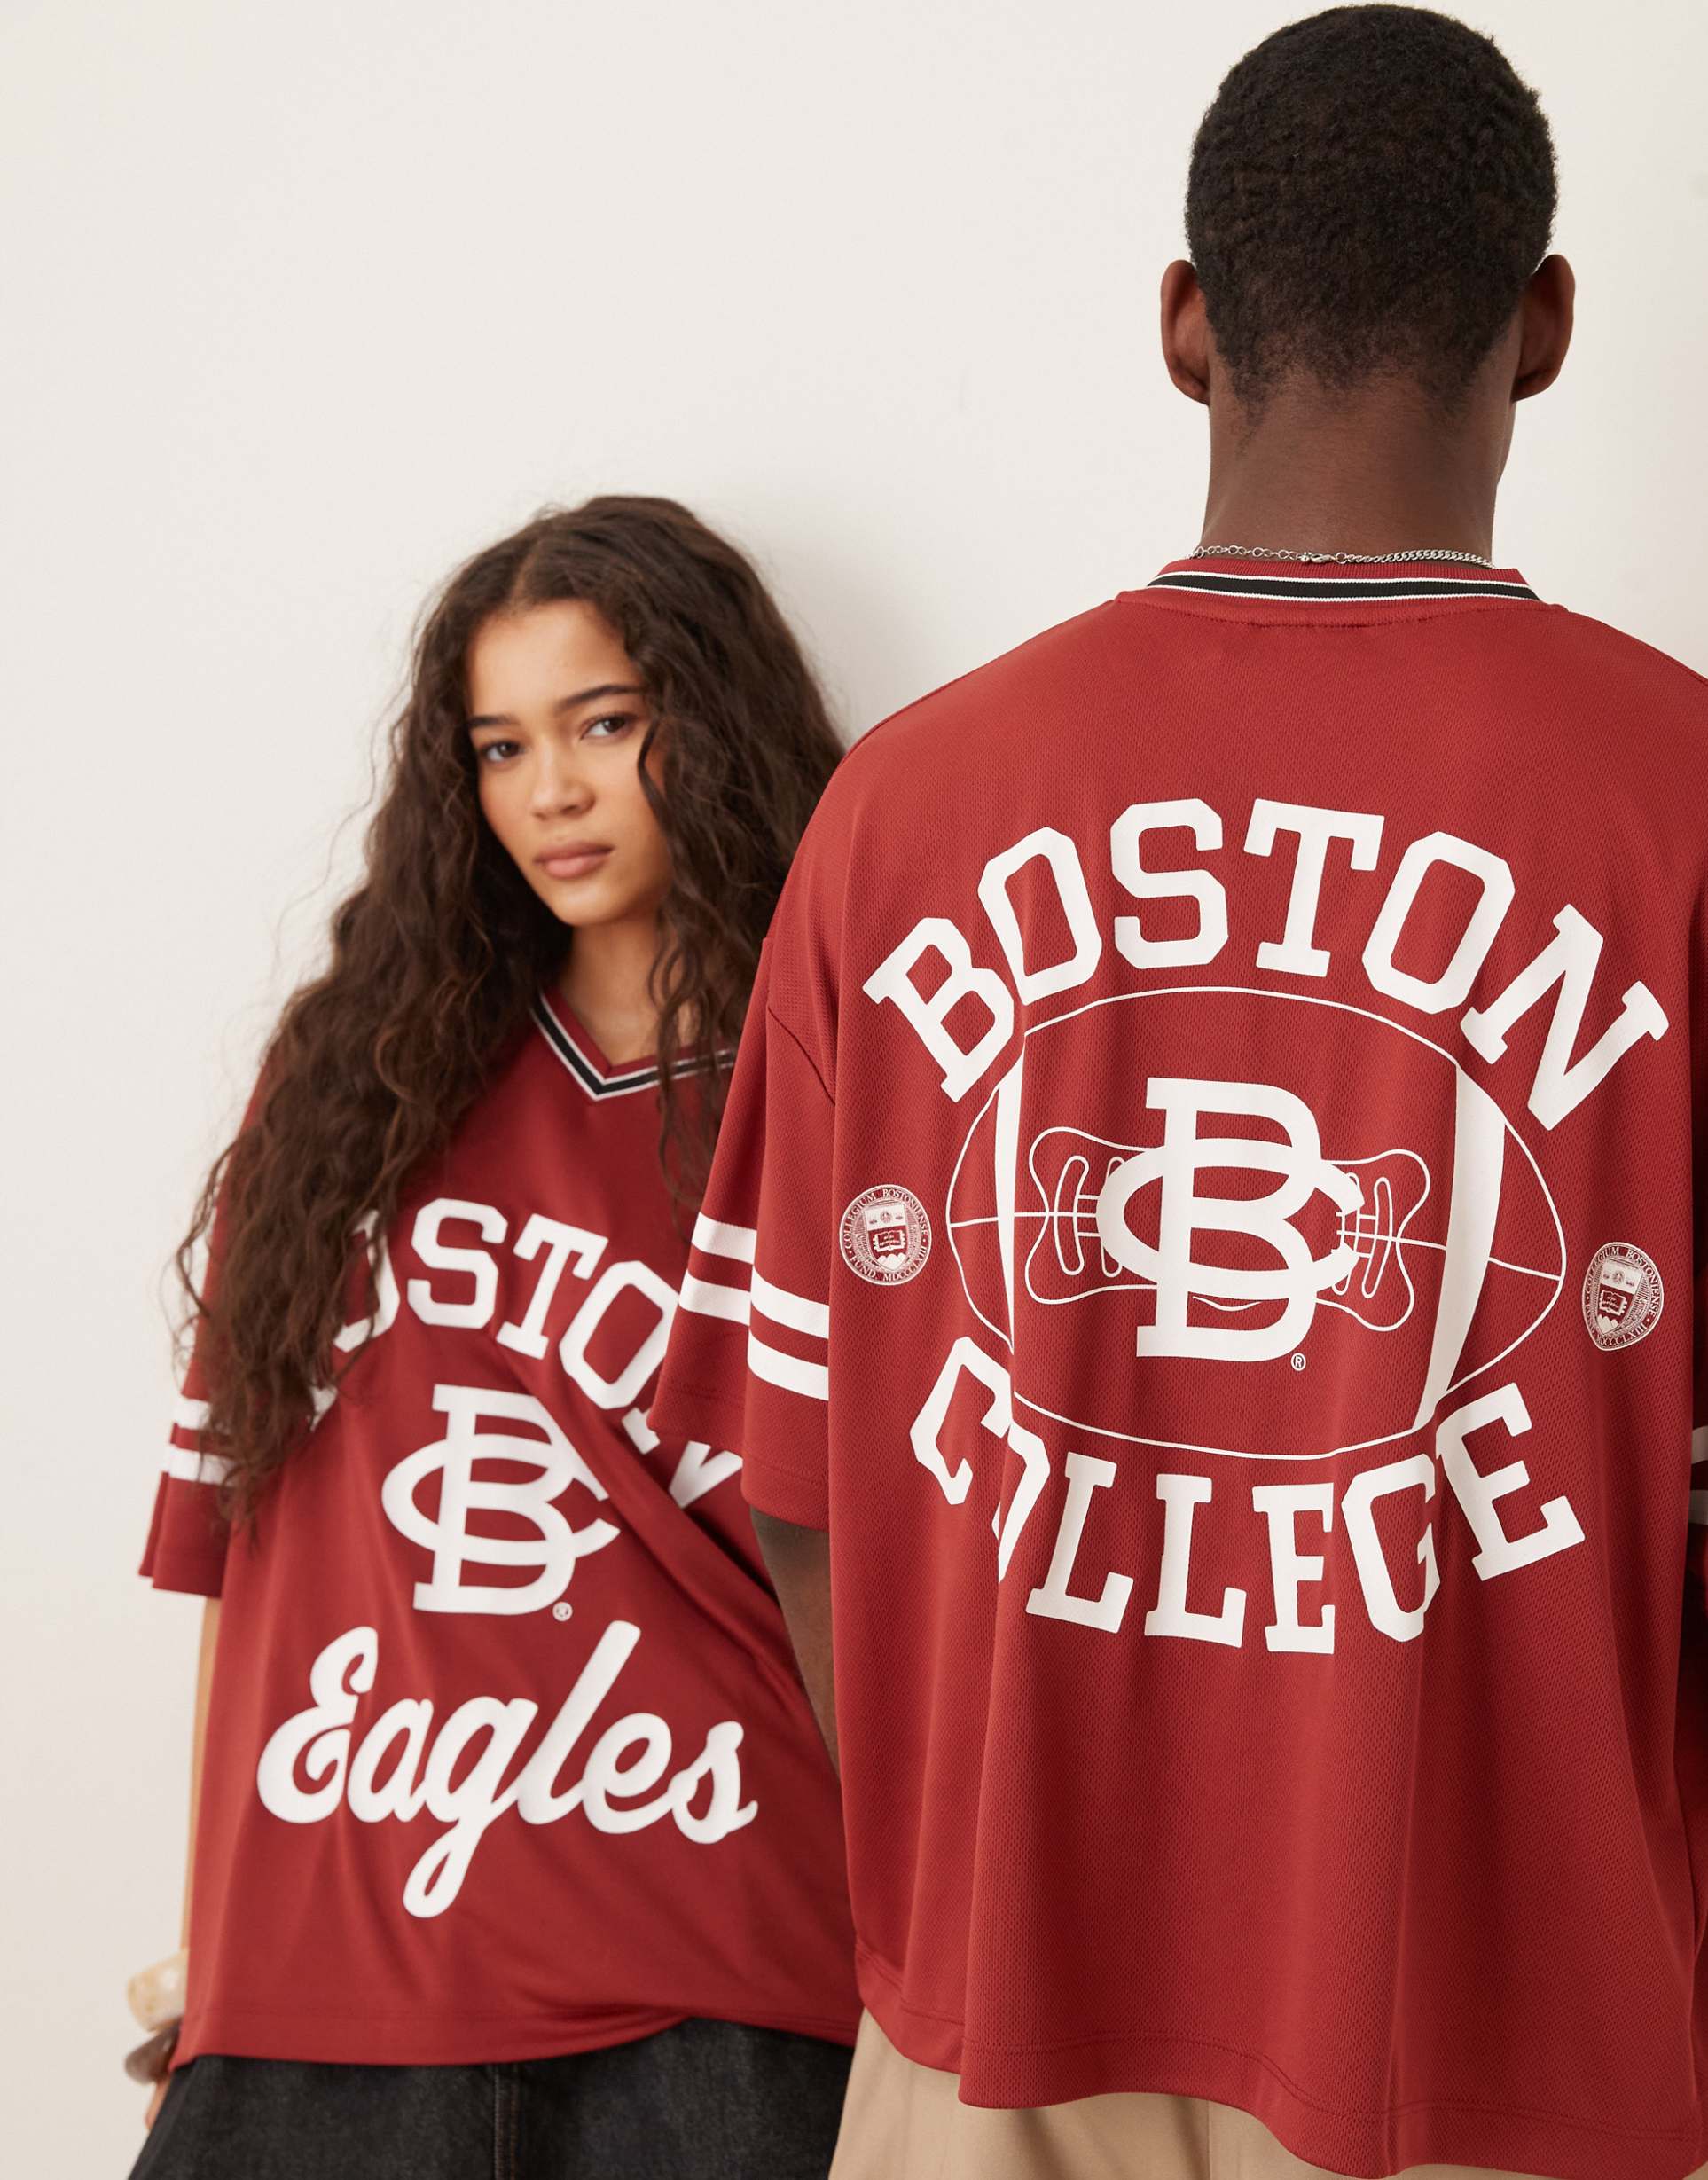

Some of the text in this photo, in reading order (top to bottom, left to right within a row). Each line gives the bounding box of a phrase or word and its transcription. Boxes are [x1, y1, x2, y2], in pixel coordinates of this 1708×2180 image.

[863, 798, 1668, 1130] BOSTON
[843, 1188, 928, 1250] COLLEGIUM BOSTONIENSE
[1626, 1249, 1660, 1318] BOSTONIENSE
[258, 1621, 757, 1917] Eagles
